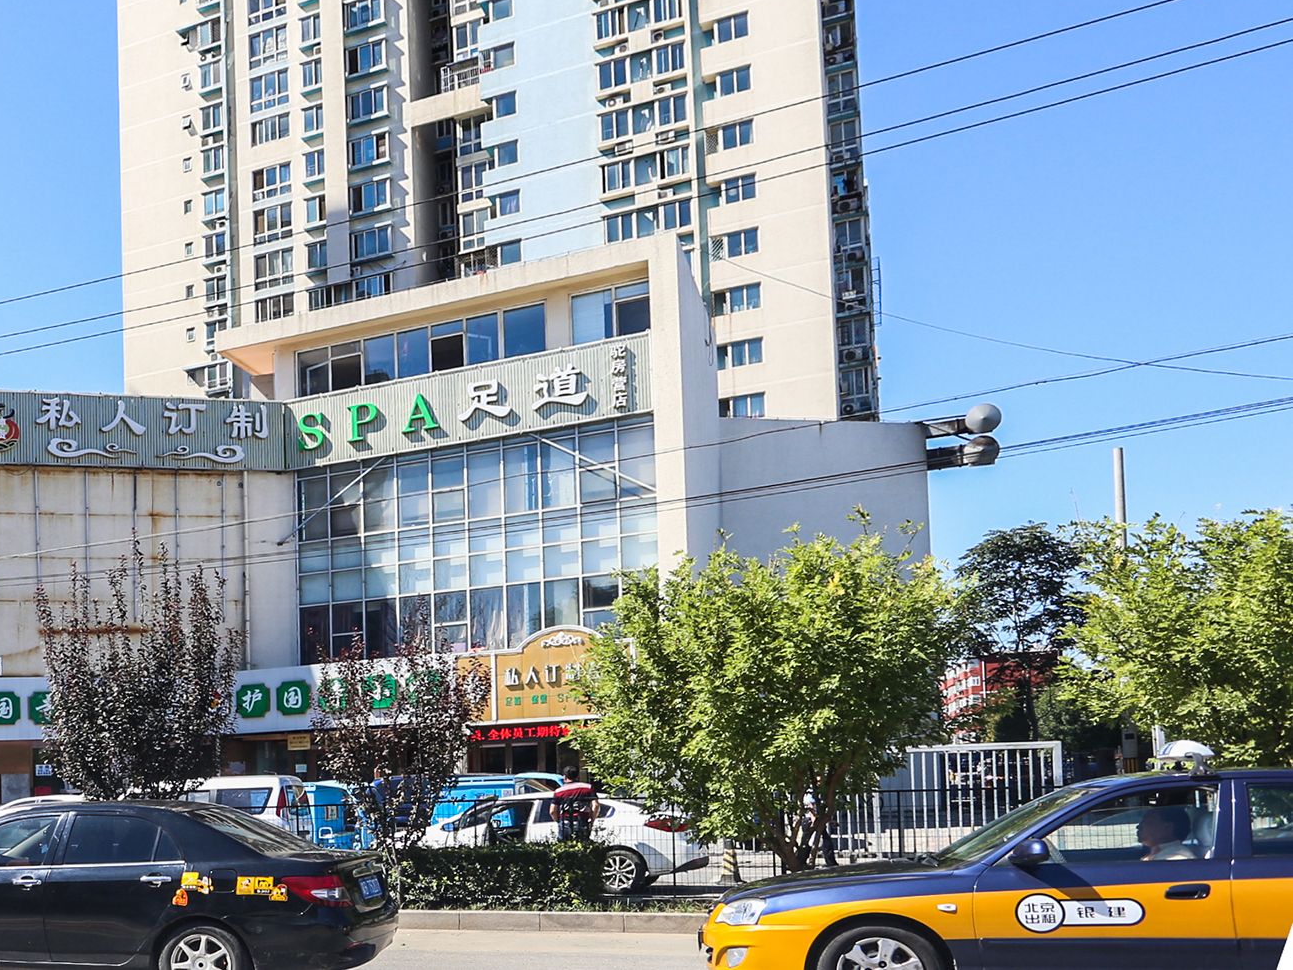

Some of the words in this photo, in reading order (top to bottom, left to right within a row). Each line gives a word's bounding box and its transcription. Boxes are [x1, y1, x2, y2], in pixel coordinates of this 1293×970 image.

[297, 392, 439, 451] SPA
[458, 363, 591, 423] 足道
[35, 397, 269, 440] 私人订制
[1024, 903, 1055, 913] 北京
[1077, 906, 1127, 919] 银建
[1025, 914, 1056, 924] 出租
